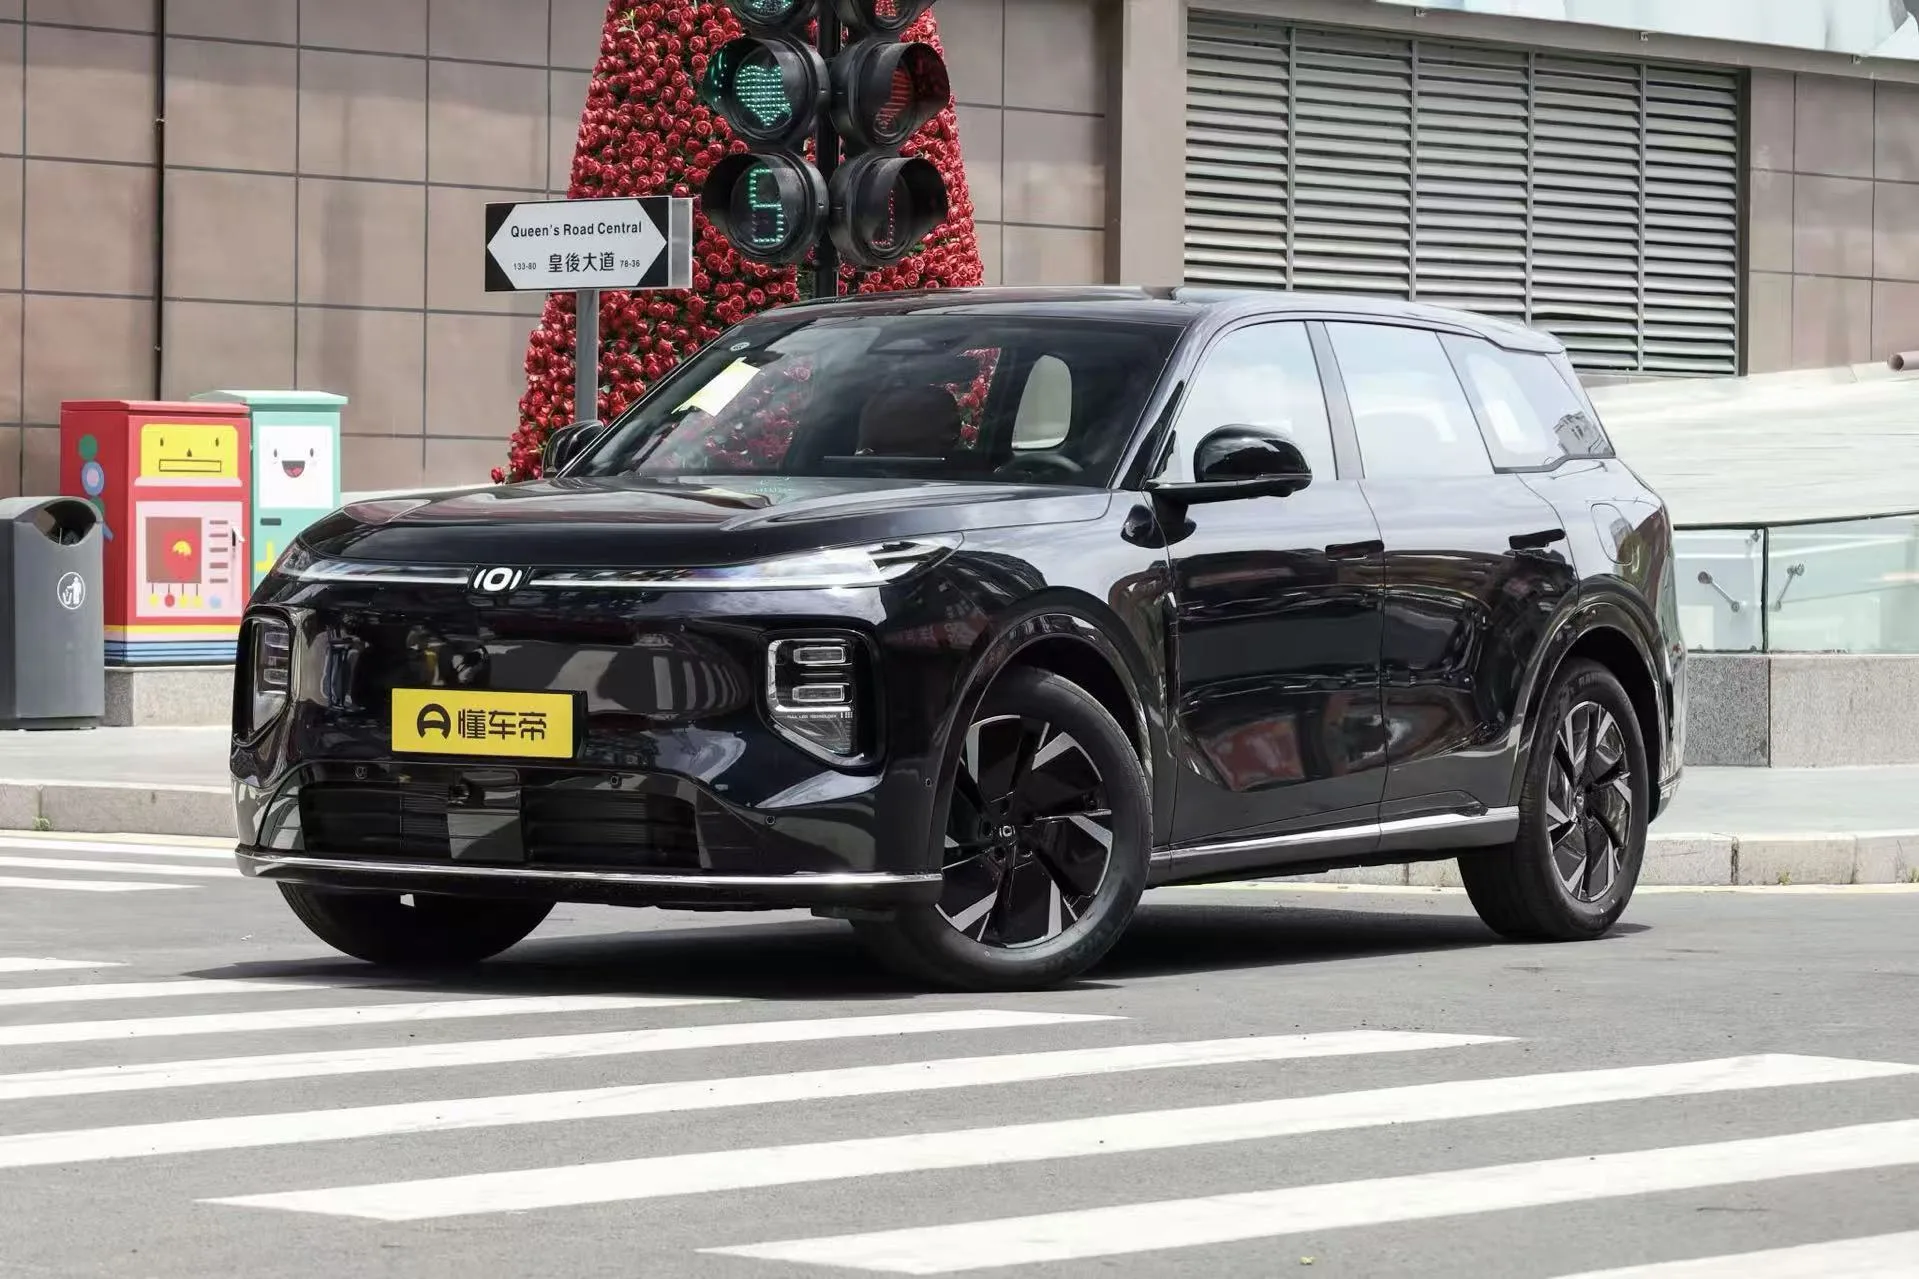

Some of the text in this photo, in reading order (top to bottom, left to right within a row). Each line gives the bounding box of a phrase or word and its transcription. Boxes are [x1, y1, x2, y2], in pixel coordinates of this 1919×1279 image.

[511, 221, 642, 237] Queen's Road Central
[513, 262, 537, 271] 133-80
[548, 251, 615, 273] 皇後大道
[620, 260, 640, 269] 78-36
[457, 708, 547, 741] 懂车帝
